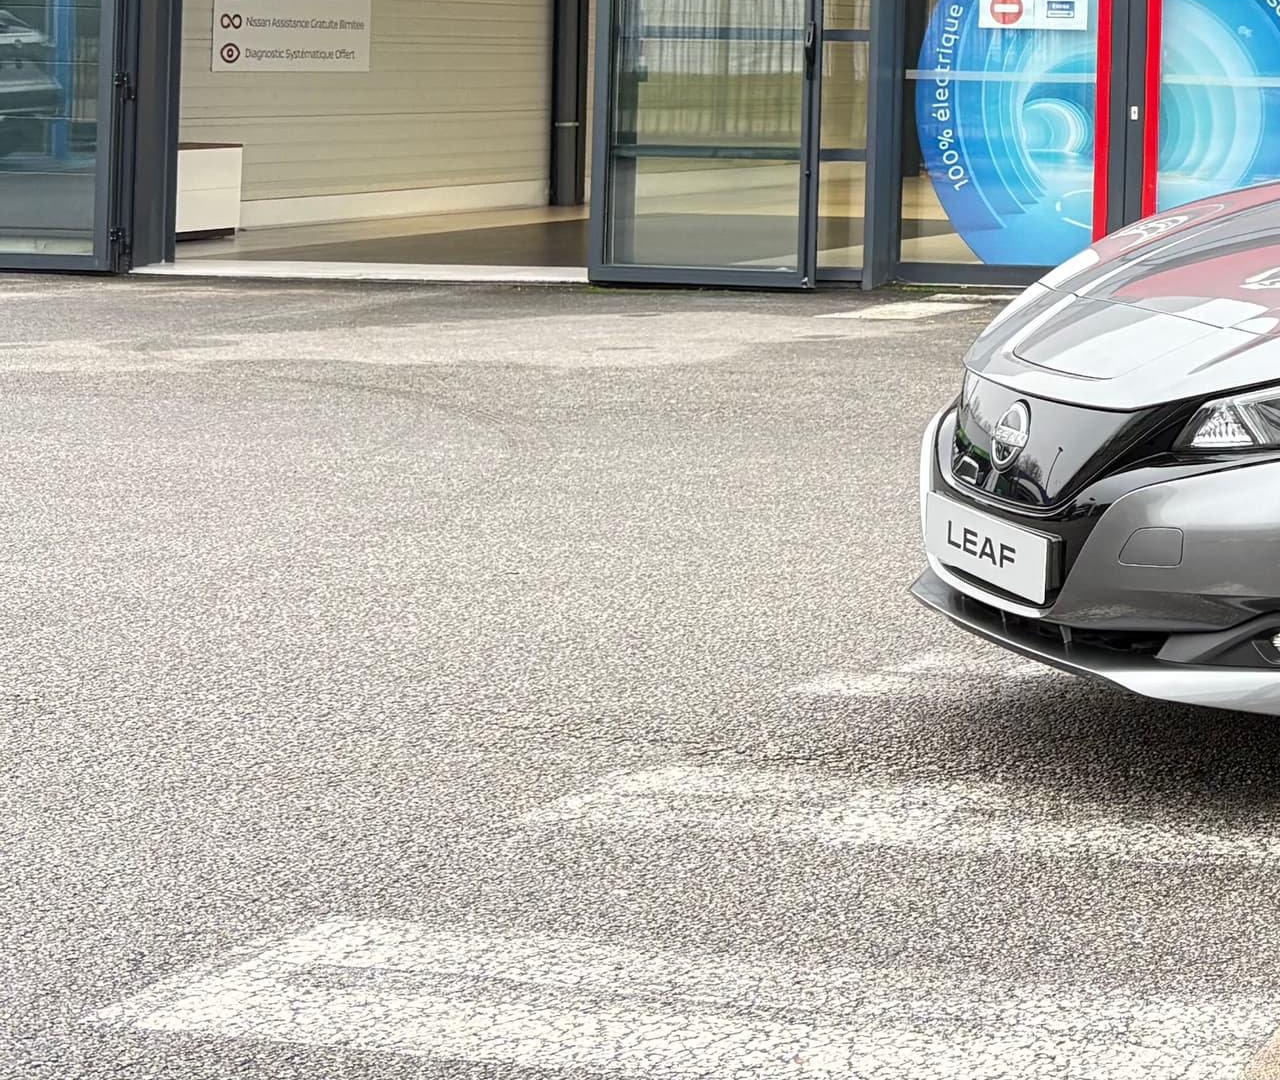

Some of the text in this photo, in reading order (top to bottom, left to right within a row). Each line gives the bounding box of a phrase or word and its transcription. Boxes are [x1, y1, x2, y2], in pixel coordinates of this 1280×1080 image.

[246, 17, 271, 28] Nissan
[272, 18, 309, 29] Assistance
[311, 19, 338, 30] Gratuite
[245, 48, 284, 61] Diagnostic
[335, 49, 355, 60] Offert
[931, 4, 969, 192] 100% électrique
[947, 520, 1016, 569] LEAF
